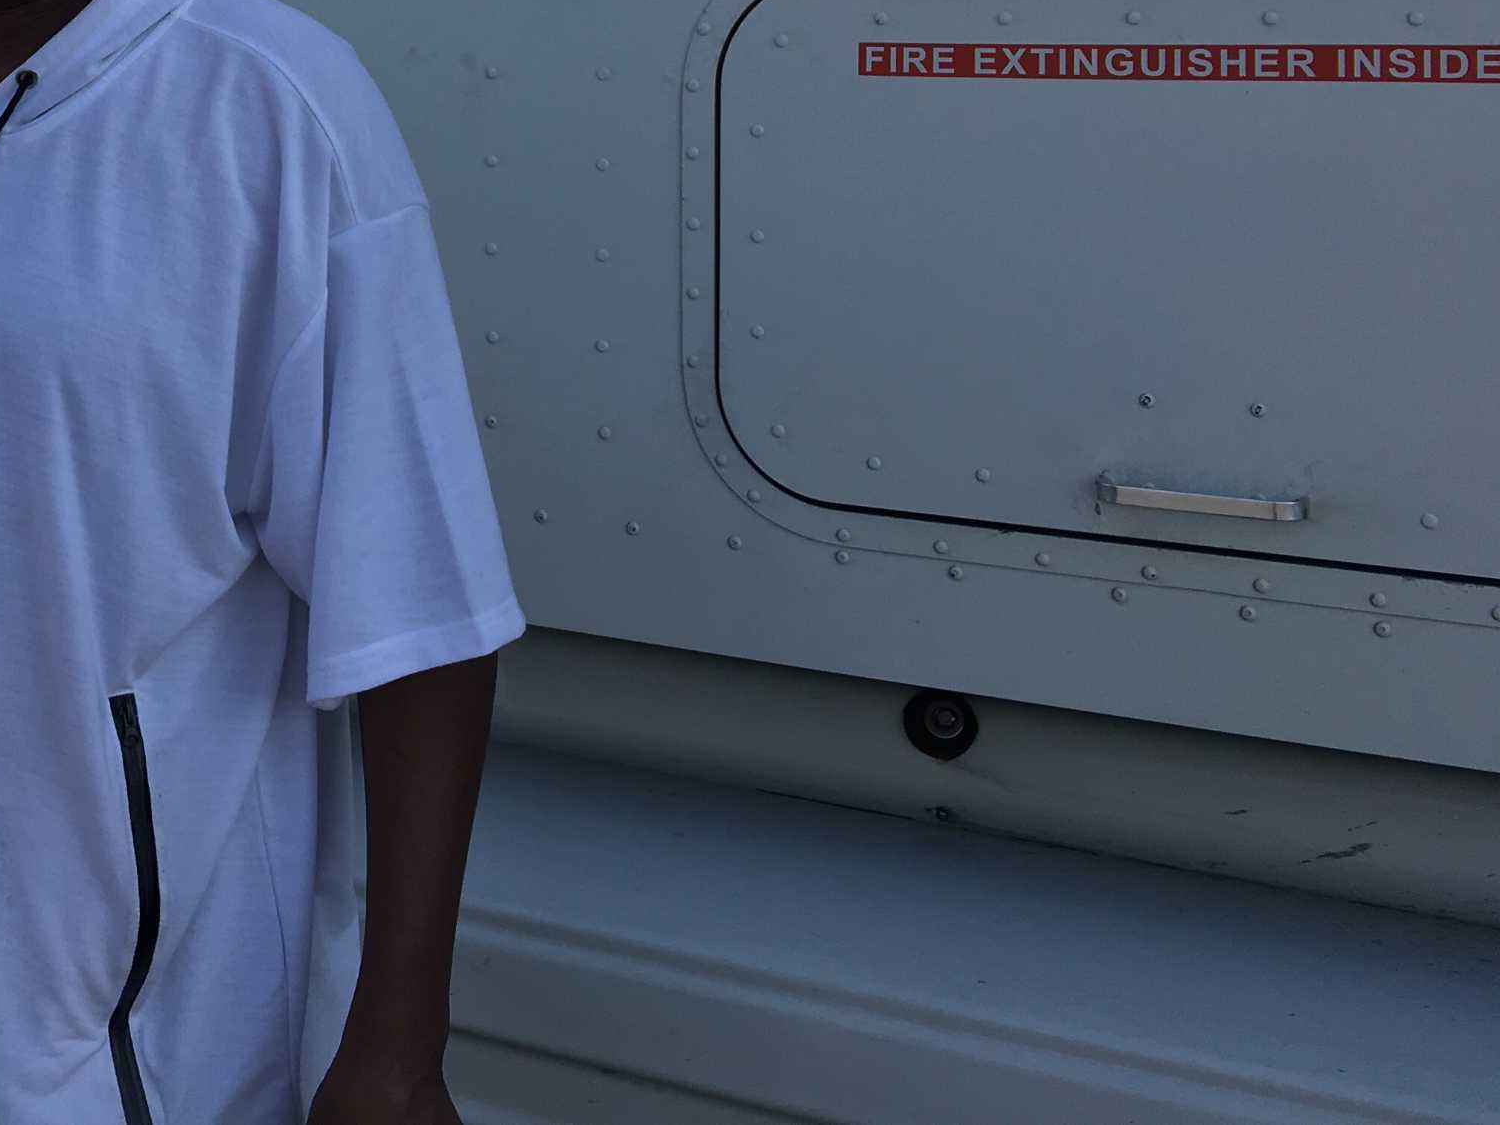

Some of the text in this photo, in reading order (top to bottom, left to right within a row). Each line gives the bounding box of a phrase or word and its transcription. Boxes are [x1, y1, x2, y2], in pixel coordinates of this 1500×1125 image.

[864, 45, 1500, 79] FIRE EXTINGUISHER INSIDE
